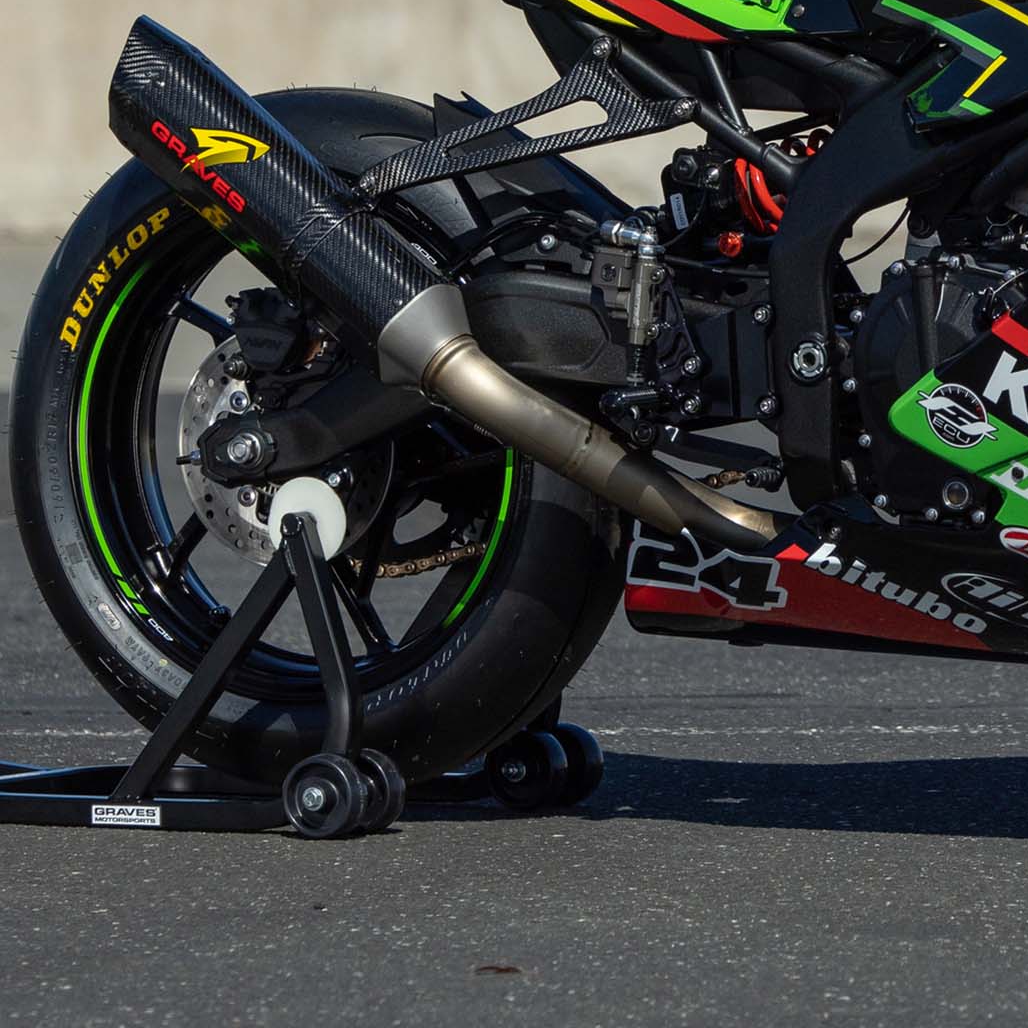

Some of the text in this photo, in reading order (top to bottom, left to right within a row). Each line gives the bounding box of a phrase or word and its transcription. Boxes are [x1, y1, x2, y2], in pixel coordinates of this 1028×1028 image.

[151, 120, 248, 214] GRAVES
[60, 207, 170, 352] DUNLOP
[932, 416, 971, 444] ECU
[626, 519, 788, 610] 24
[804, 543, 988, 634] bitubo
[94, 807, 157, 818] GRAVES
